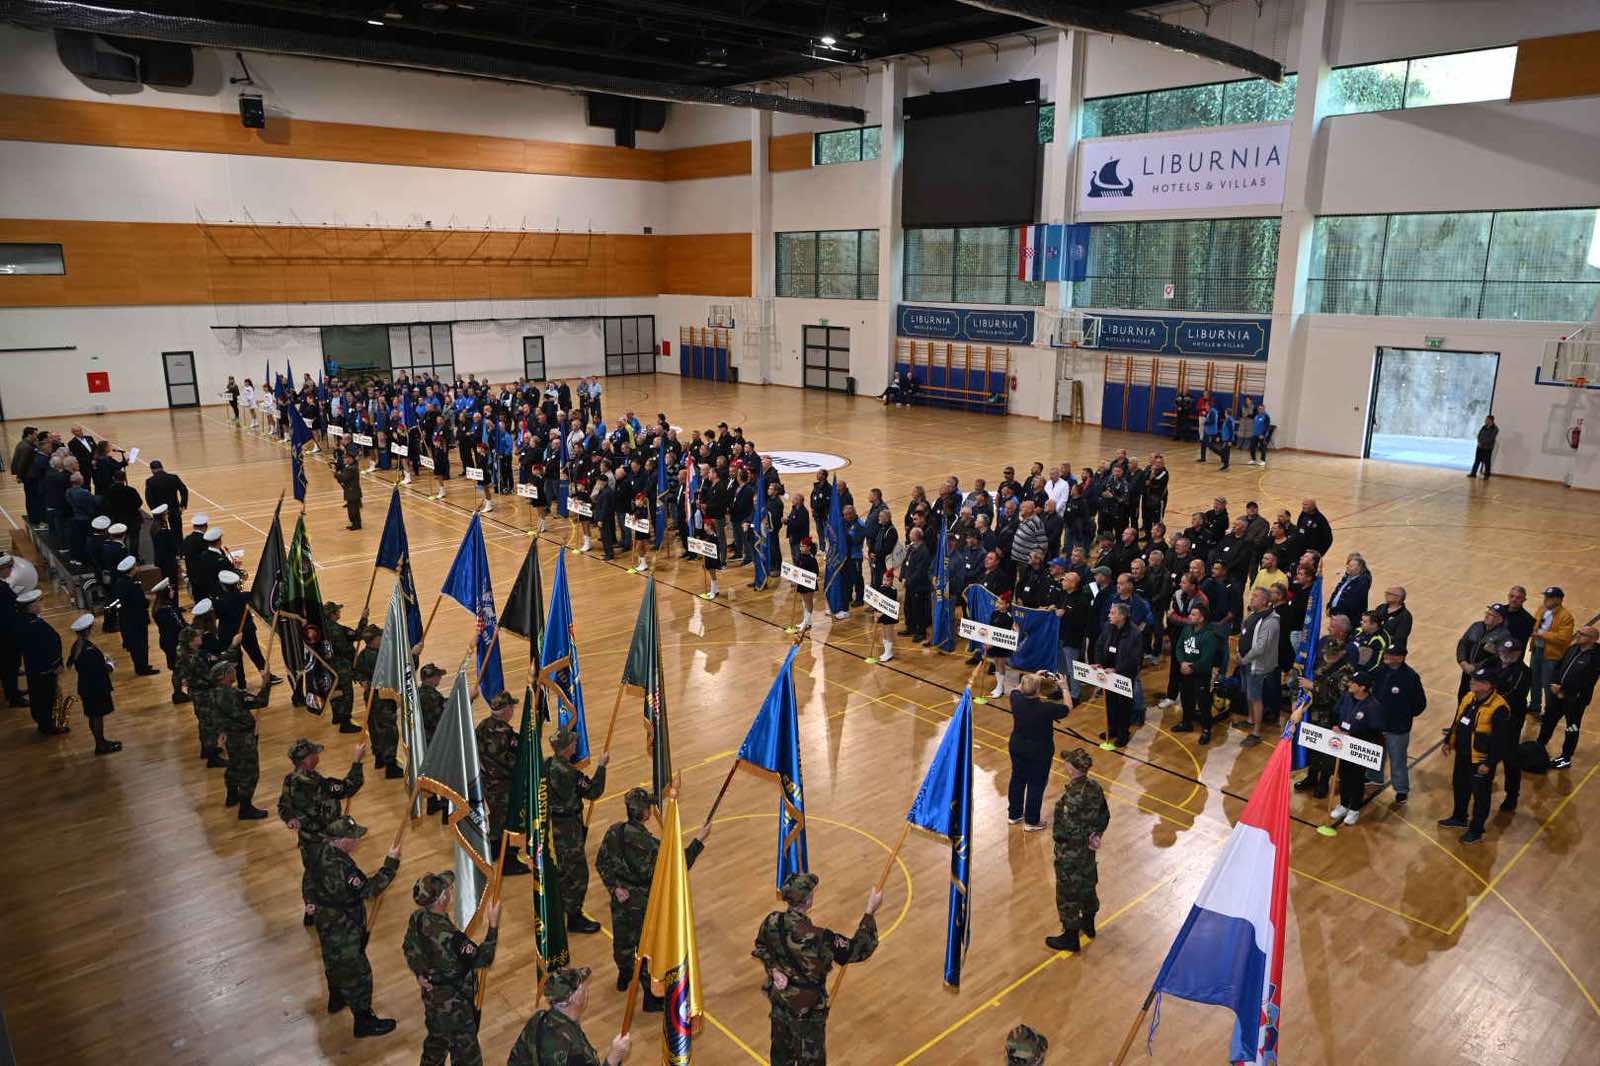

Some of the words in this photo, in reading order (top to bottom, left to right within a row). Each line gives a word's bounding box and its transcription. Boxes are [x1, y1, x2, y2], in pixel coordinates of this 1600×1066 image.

[1142, 145, 1281, 176] LIBURNIA
[1152, 182, 1200, 193] HOTELS
[1206, 181, 1213, 190] &
[1220, 177, 1267, 189] VILLAS
[911, 315, 951, 325] LIBURNIA
[973, 319, 1018, 329] LIBURNIA
[1101, 325, 1156, 336] LIBURNIA
[1188, 328, 1251, 340] LIBURNIA
[1349, 742, 1381, 758] OGRANAK
[1350, 750, 1378, 764] OPATIJA
